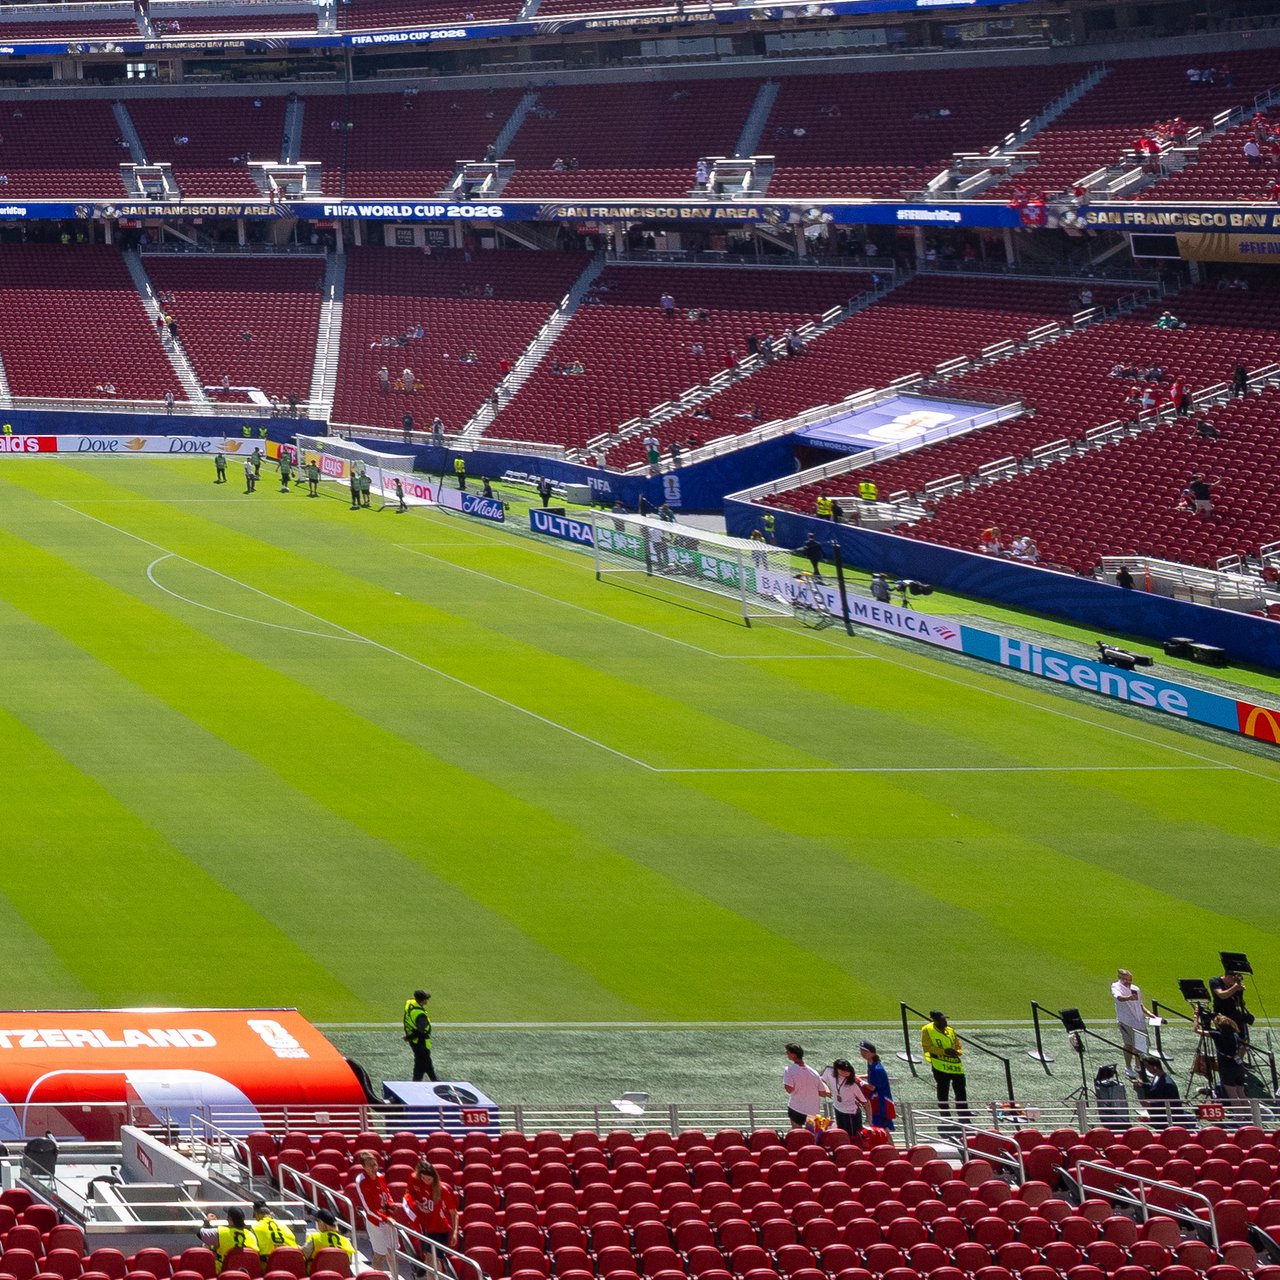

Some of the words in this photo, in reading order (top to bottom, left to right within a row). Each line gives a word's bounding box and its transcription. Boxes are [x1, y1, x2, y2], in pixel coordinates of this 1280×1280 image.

[122, 206, 146, 215] SAN
[149, 206, 216, 214] FRANCISCO
[218, 206, 241, 215] BAY
[244, 206, 276, 215] AREA
[359, 206, 412, 218] WORLD
[414, 206, 445, 218] CUP
[447, 206, 503, 218] 2026
[557, 208, 587, 217] SAN
[590, 208, 677, 217] FRANCISCO
[680, 208, 711, 218] BAY
[715, 208, 759, 218] AREA
[1086, 212, 1121, 224] SAN
[1124, 212, 1226, 225] FRANCISCO
[1230, 214, 1267, 226] BAY
[78, 436, 118, 453] Dove
[168, 437, 211, 454] Dove
[587, 477, 612, 493] FIFA
[535, 512, 593, 543] ULTRA
[1000, 635, 1188, 717] Hisense
[466, 1113, 487, 1123] 136
[1203, 1107, 1222, 1118] 135
